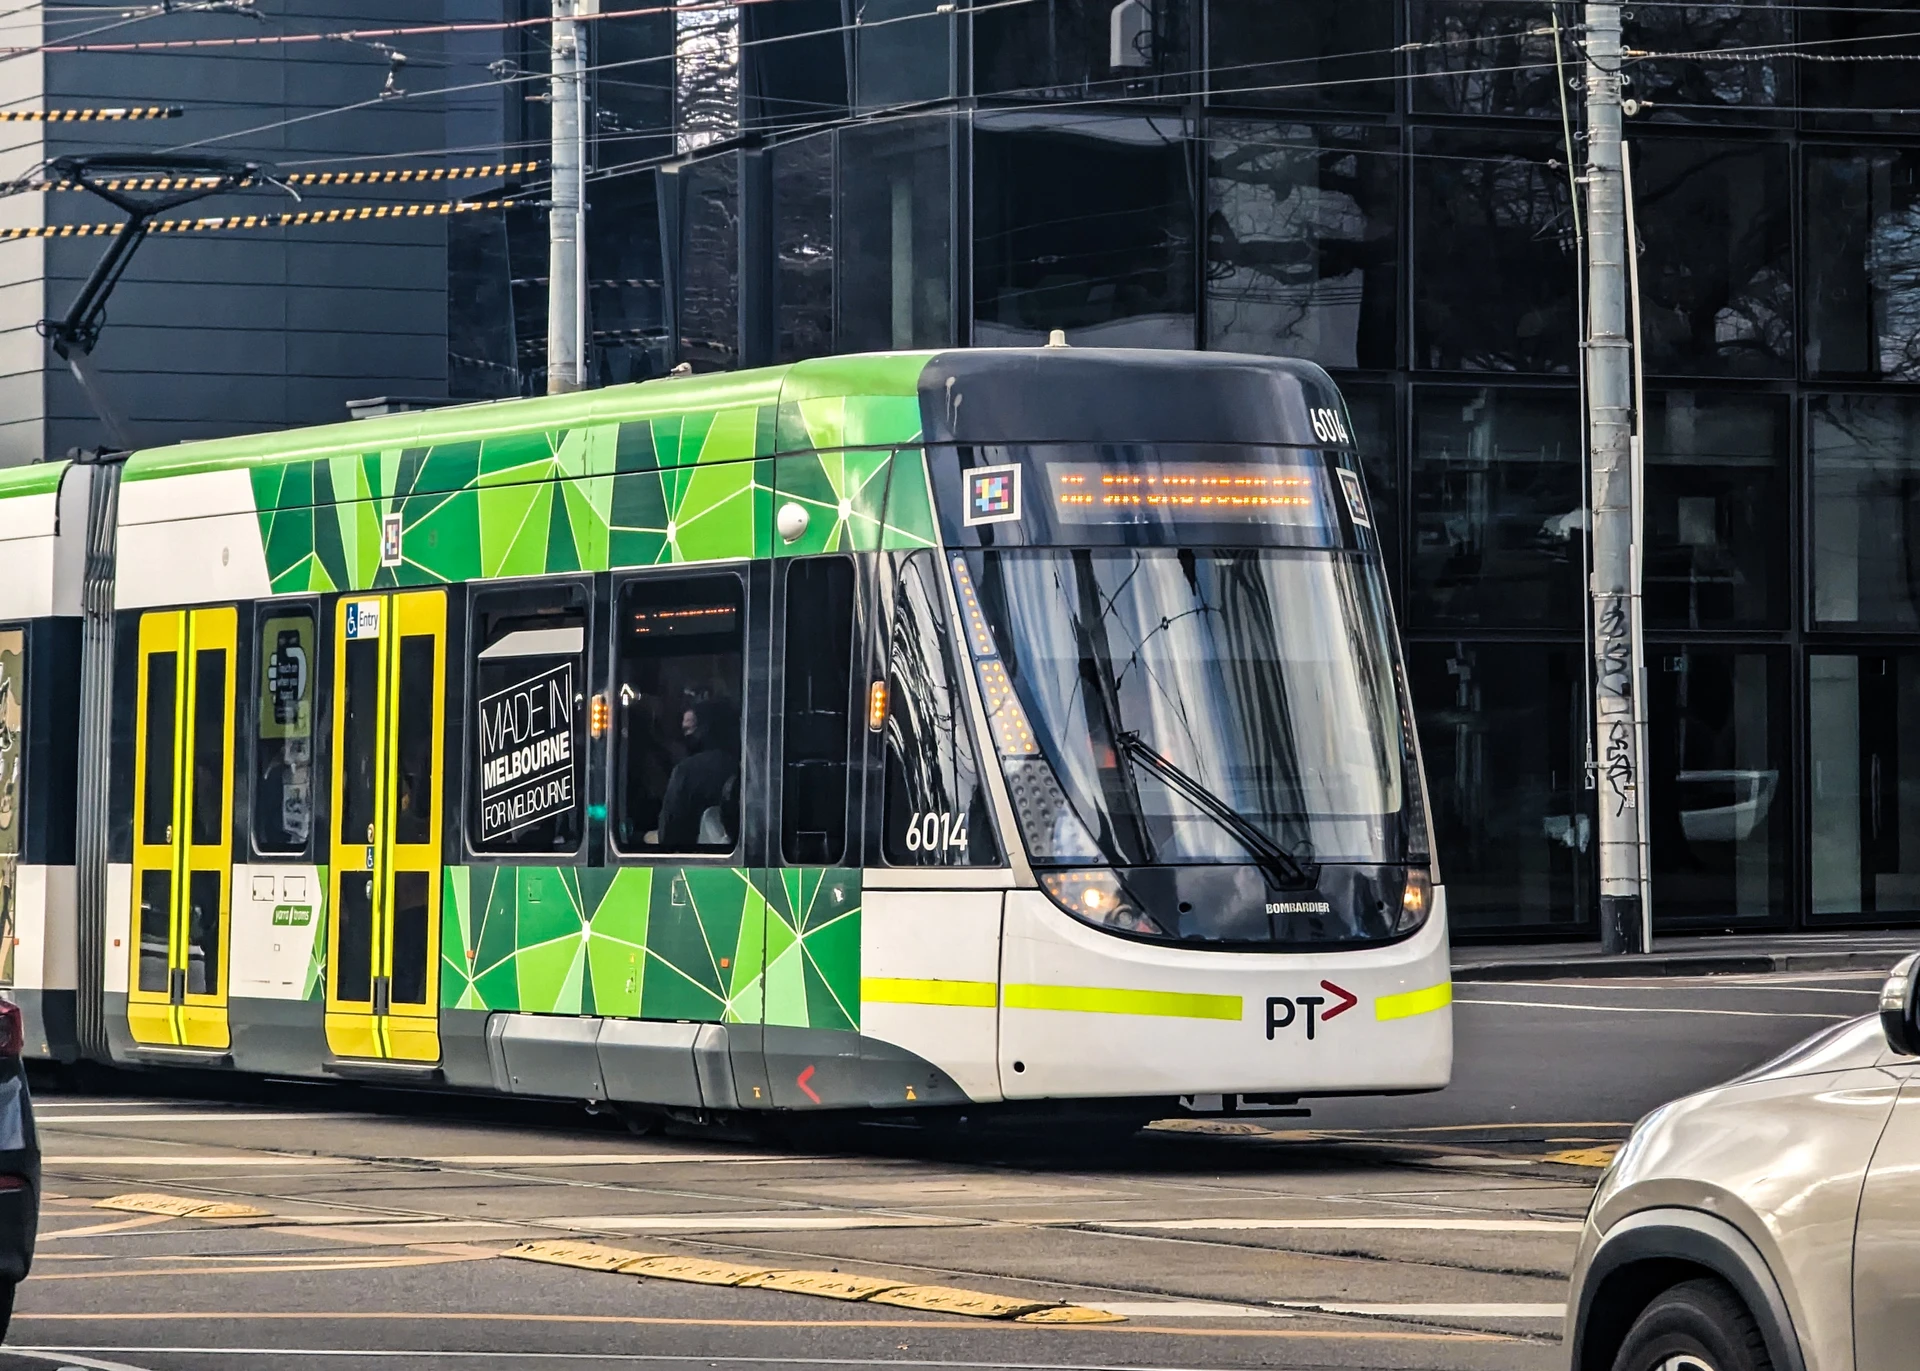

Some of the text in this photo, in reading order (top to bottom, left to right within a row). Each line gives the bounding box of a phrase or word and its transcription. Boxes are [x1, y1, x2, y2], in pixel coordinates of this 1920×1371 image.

[1310, 408, 1349, 444] 6014
[359, 610, 379, 631] Entry
[482, 673, 569, 757] MADE IN
[483, 730, 570, 791] MELBOURNE
[485, 775, 571, 831] FOR MELBOURNE
[906, 812, 968, 851] 6014
[1265, 902, 1330, 914] BOMBARDIER
